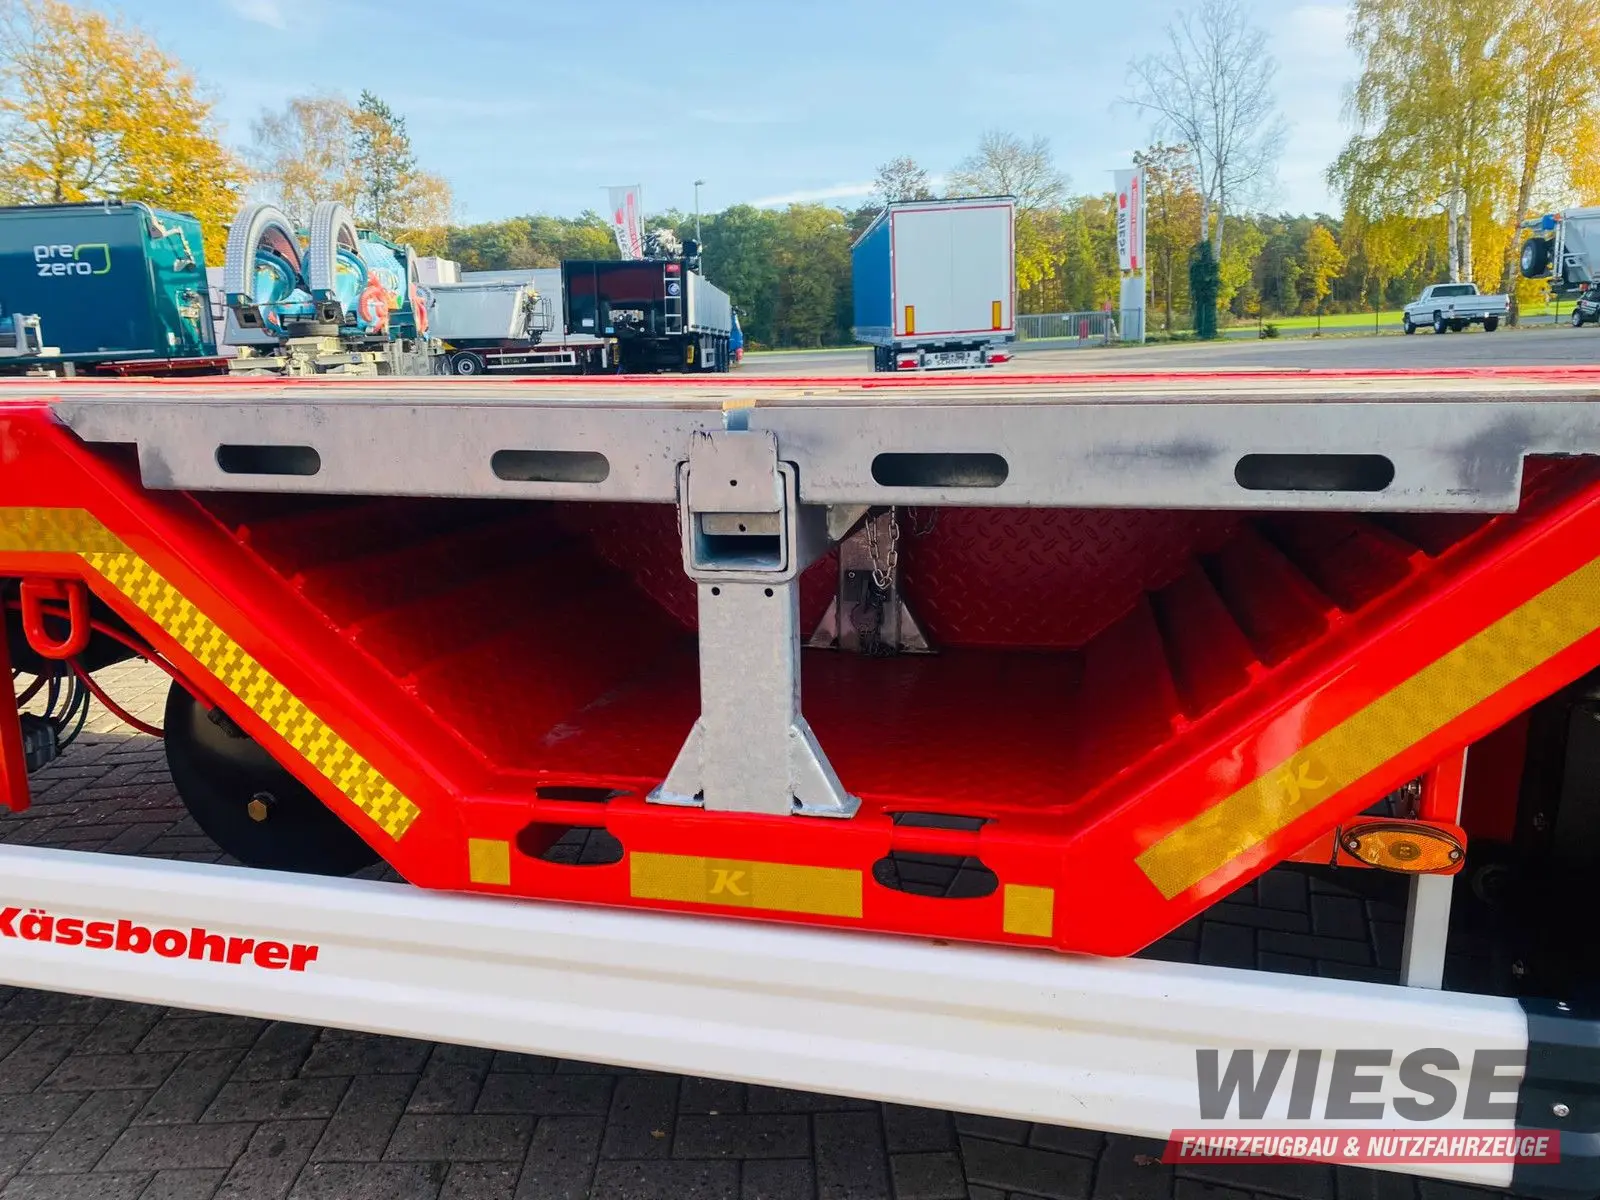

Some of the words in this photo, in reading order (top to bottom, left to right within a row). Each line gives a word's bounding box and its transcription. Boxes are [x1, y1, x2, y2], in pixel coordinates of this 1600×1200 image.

[33, 244, 74, 262] pre
[36, 261, 92, 277] zero
[709, 869, 750, 896] K
[0, 907, 319, 972] Kässbohrer
